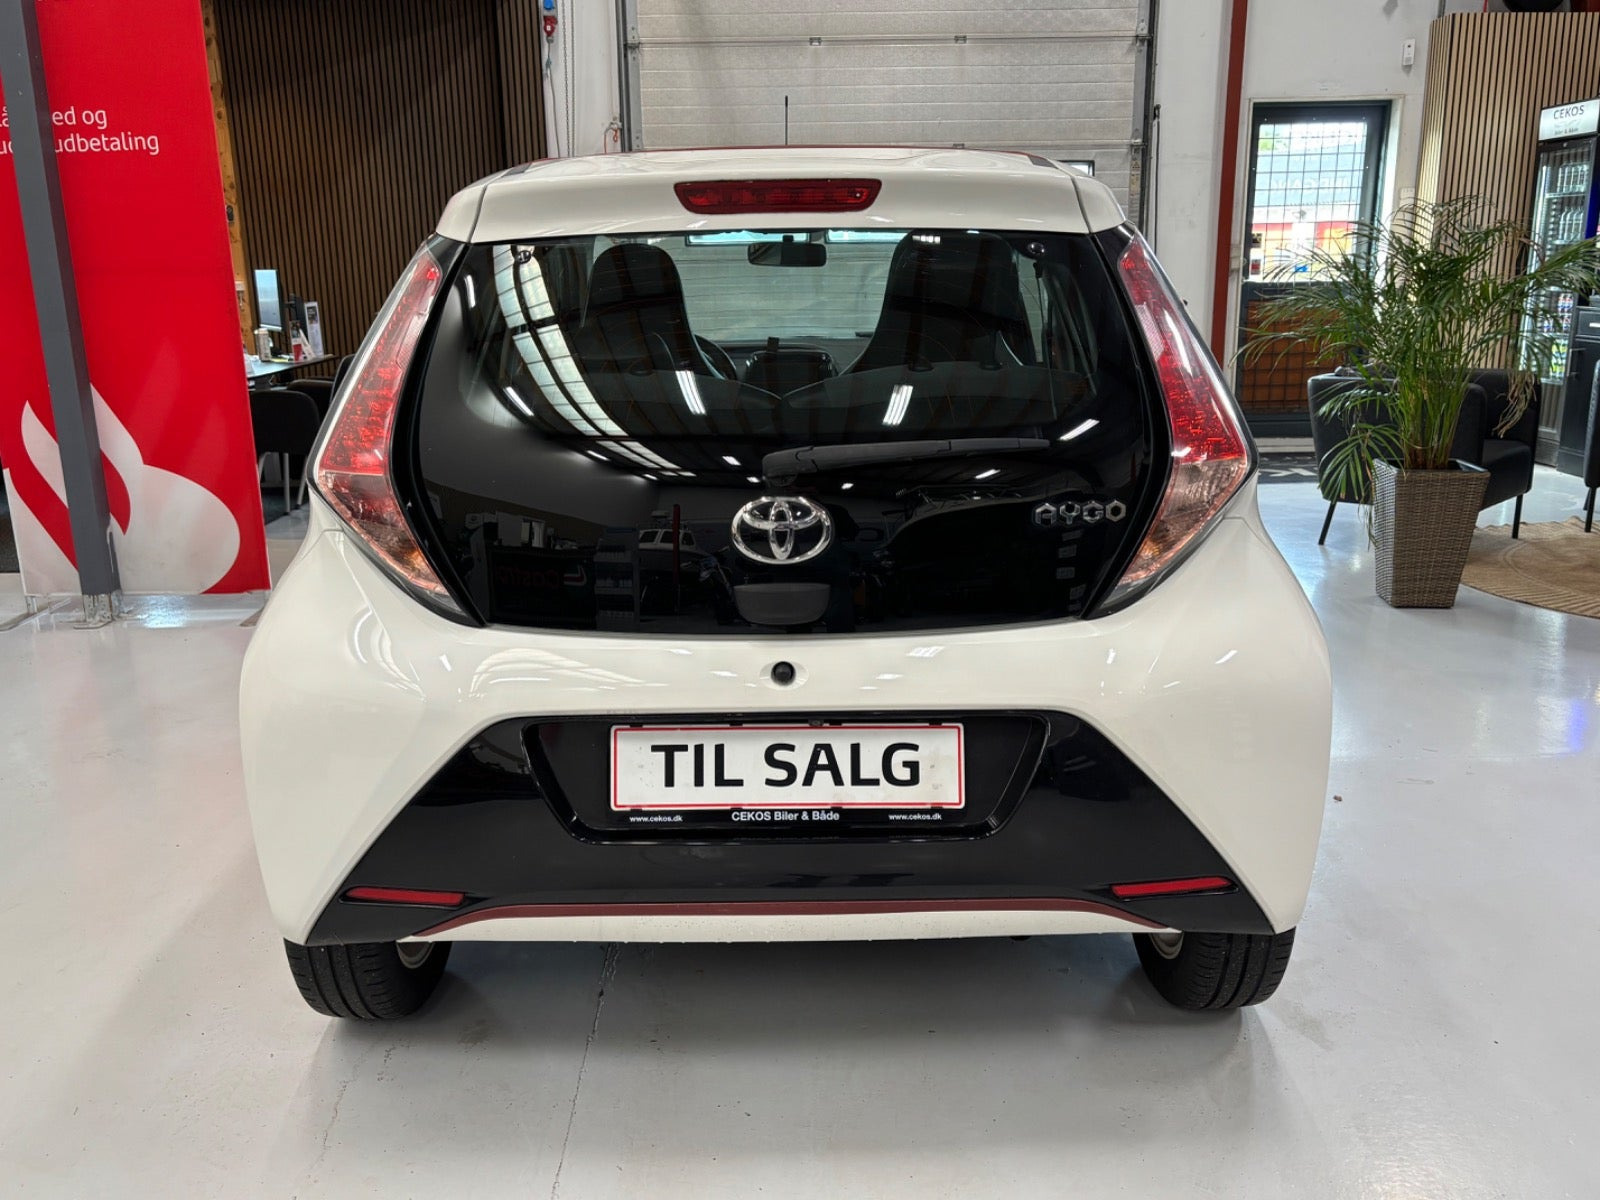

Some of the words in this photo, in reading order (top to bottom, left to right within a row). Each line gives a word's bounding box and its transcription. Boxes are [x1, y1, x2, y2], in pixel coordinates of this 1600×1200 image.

[51, 105, 77, 126] ed
[81, 109, 108, 130] og
[1553, 104, 1585, 120] CEKOS
[1035, 499, 1127, 525] AYGO
[650, 743, 745, 788] TIL
[763, 742, 921, 788] SALG
[629, 814, 683, 823] www.cekos.dk
[731, 811, 772, 822] CEKOS
[773, 811, 799, 821] Biler
[801, 811, 810, 821] &
[812, 810, 840, 821] Både
[888, 812, 942, 821] www.cekos.dk
